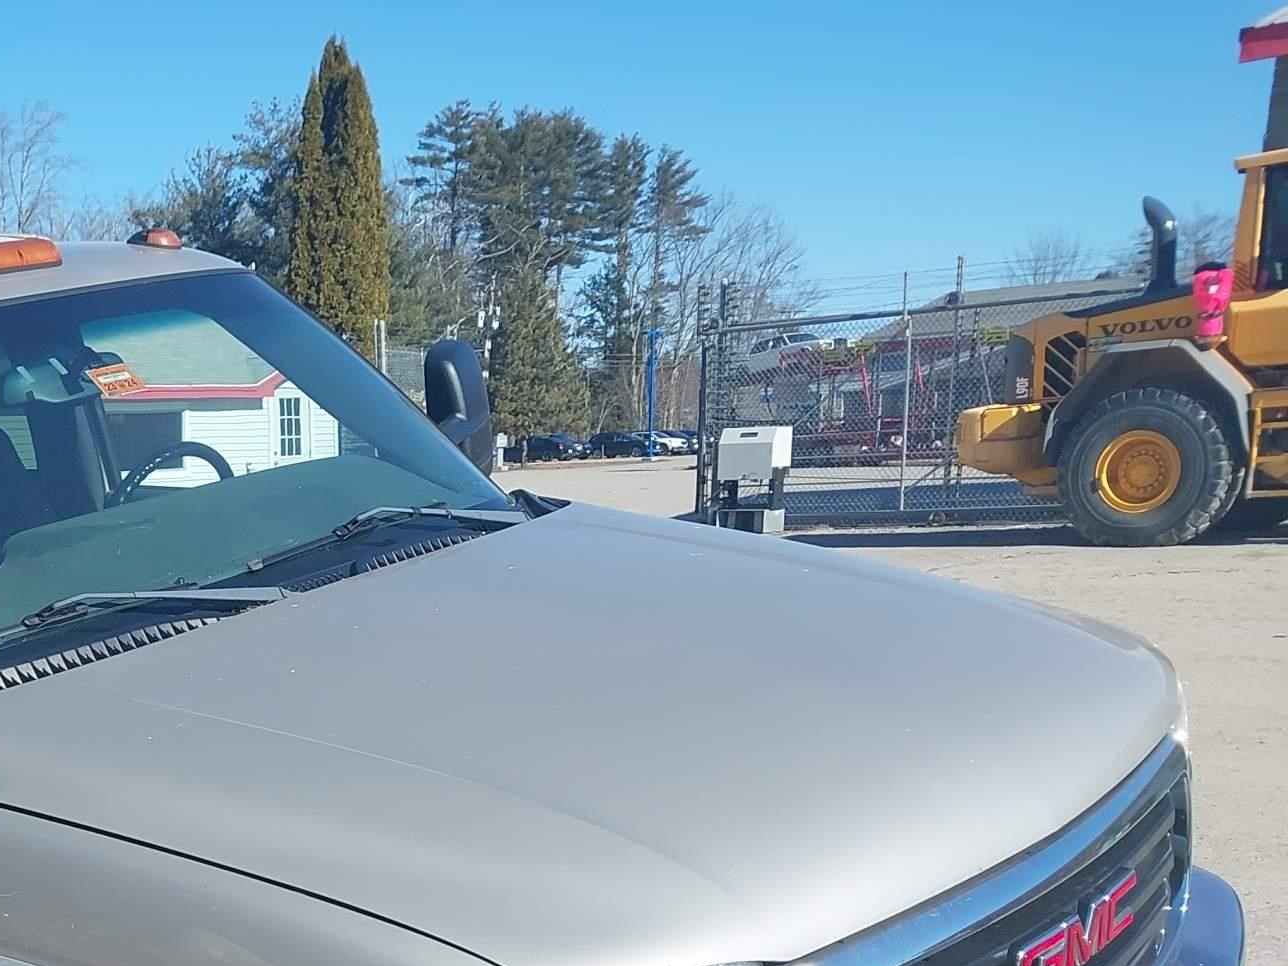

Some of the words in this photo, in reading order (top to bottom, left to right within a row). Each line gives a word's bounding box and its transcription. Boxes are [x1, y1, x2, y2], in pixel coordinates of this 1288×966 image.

[1098, 315, 1193, 338] VOLVO
[123, 376, 139, 388] 24
[1015, 376, 1029, 399] L90F
